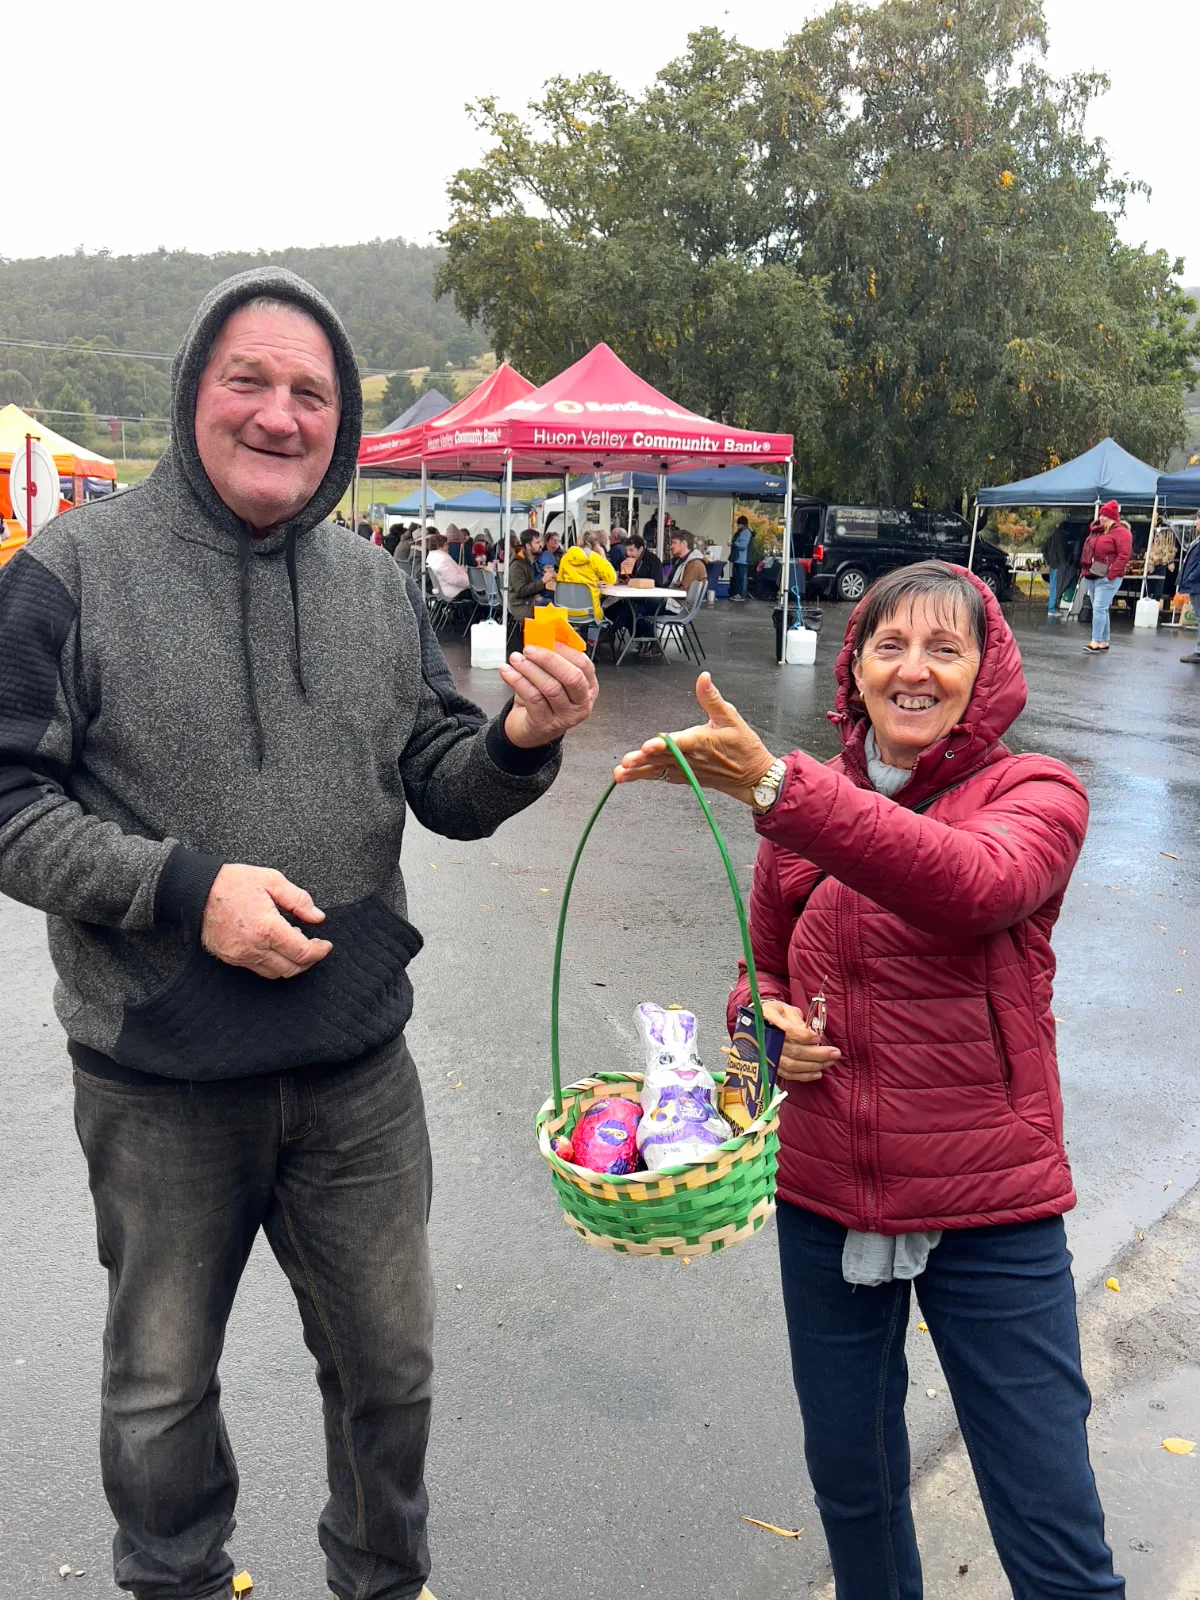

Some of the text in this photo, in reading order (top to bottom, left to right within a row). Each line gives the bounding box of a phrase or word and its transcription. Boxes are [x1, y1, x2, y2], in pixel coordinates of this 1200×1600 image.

[427, 436, 441, 450] Huon
[454, 428, 483, 446] Community
[534, 428, 577, 445] Huon
[581, 430, 628, 449] Valley
[632, 432, 719, 452] Community
